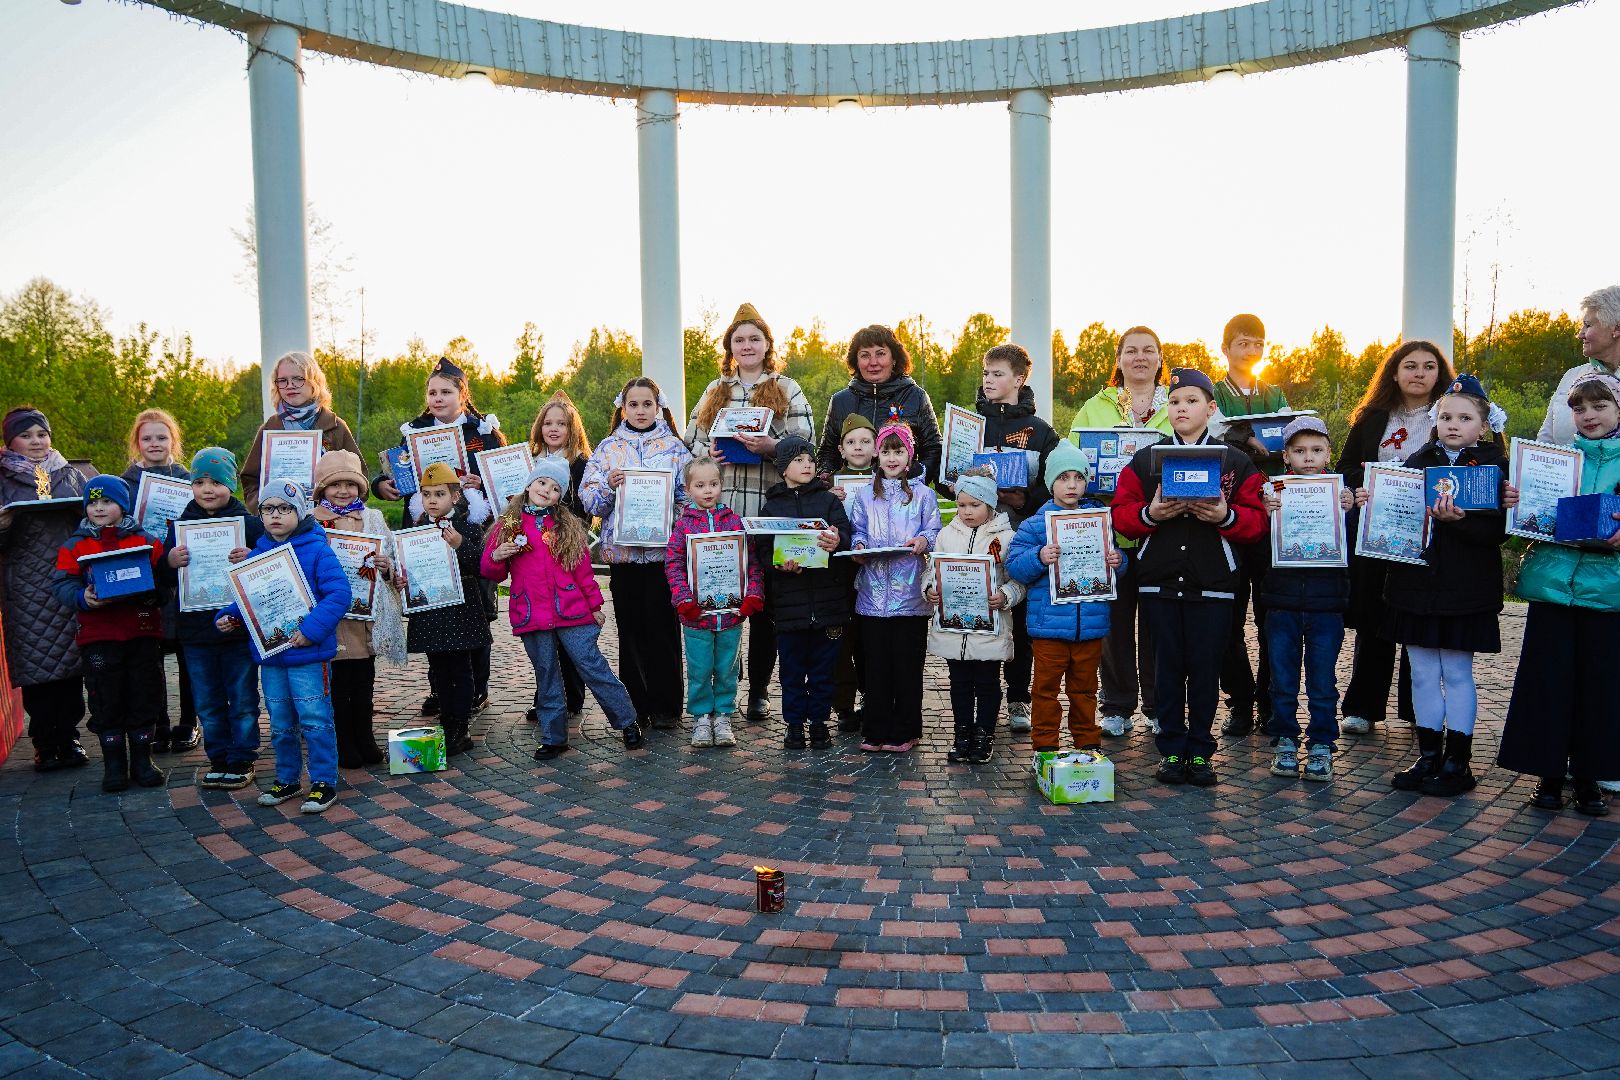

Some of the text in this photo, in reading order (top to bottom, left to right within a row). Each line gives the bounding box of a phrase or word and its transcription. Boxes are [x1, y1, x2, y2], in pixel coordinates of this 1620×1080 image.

[1529, 453, 1568, 467] ДИПЛОМ
[1382, 478, 1422, 490] ДИПЛОМ
[156, 486, 190, 498] ДИПЛОМ
[1288, 486, 1326, 494] ДИПЛОМ
[1063, 521, 1098, 530] ДИПЛОМ
[193, 530, 229, 540] ДИПЛОМ
[409, 535, 440, 547] ДИПЛОМ
[336, 542, 370, 552] ДИПЛОМ
[703, 543, 734, 552] ДИПЛОМ
[247, 561, 283, 582] ДИПЛОМ
